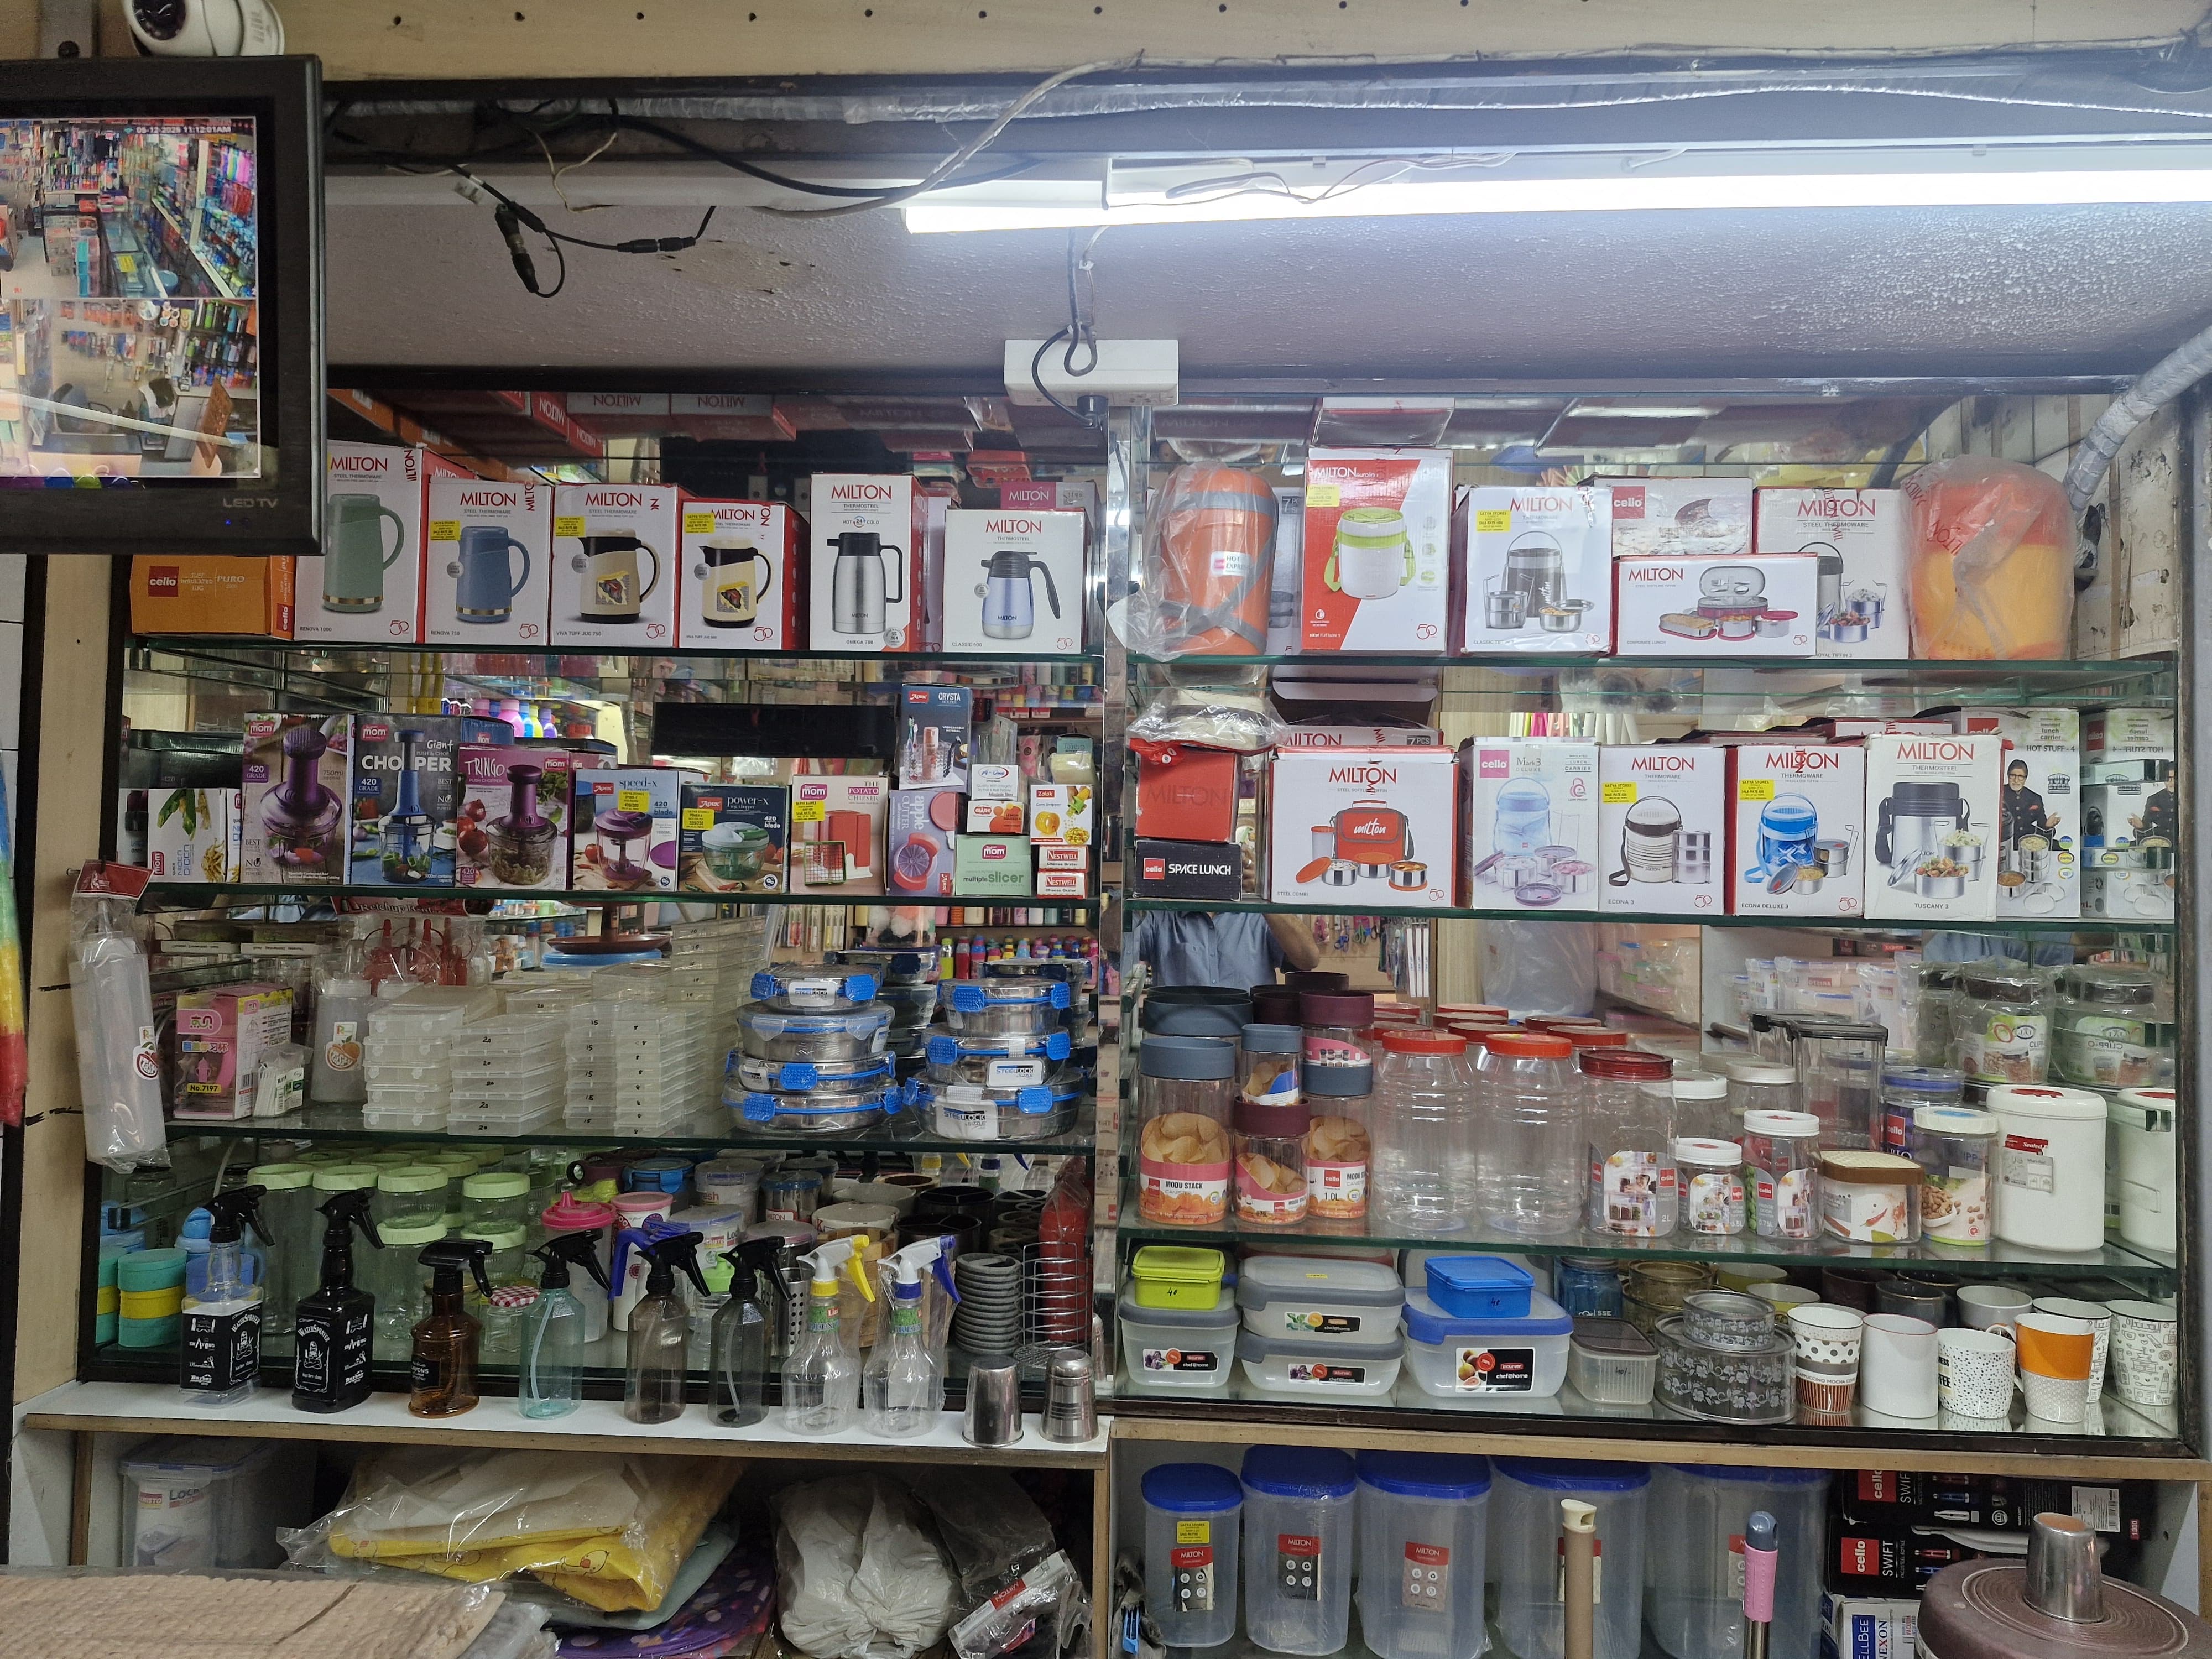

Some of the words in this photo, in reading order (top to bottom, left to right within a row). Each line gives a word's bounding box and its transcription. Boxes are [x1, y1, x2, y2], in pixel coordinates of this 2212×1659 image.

[330, 457, 388, 472] MILTON
[1315, 467, 1357, 478] MILTON
[832, 484, 892, 500] MILTON
[1009, 491, 1049, 502] MILTON
[222, 498, 254, 508] LED
[255, 499, 278, 508] TV
[460, 492, 517, 507] MILTON
[586, 493, 642, 507] MILTON
[1510, 497, 1572, 512] MILTON
[1614, 499, 1641, 508] cello
[712, 509, 755, 520] MILTON
[1797, 499, 1876, 517] MILTON
[985, 520, 1042, 534] MILTON
[149, 577, 176, 586] cello
[1629, 568, 1683, 581] MILTON
[938, 692, 961, 701] CRYSTA
[426, 739, 453, 753] Giant
[1897, 743, 1974, 760] MILTON
[361, 756, 452, 771] CHOPER
[465, 758, 505, 777] TRINGO
[1631, 757, 1694, 771] MILTON
[1765, 752, 1839, 769] MILTON
[619, 778, 658, 788] speed-x
[1328, 768, 1397, 784] MILTON
[727, 796, 769, 806] power-x
[914, 796, 924, 830] apple
[1353, 818, 1386, 835] milton
[1047, 850, 1078, 860] NESTWELL
[1168, 864, 1198, 875] SPACE
[1200, 864, 1231, 875] LUNCH
[988, 872, 1024, 883] slicer
[1046, 877, 1077, 886] NESTWELL
[944, 1111, 987, 1121] STEELLOCK
[1324, 1193, 1340, 1201] 1.0L
[1901, 1473, 1911, 1503] SWIF
[1288, 1538, 1312, 1547] MILTON
[1415, 1547, 1440, 1556] MILTON
[1855, 1541, 1865, 1572] cello
[1883, 1541, 1893, 1576] SWIFT
